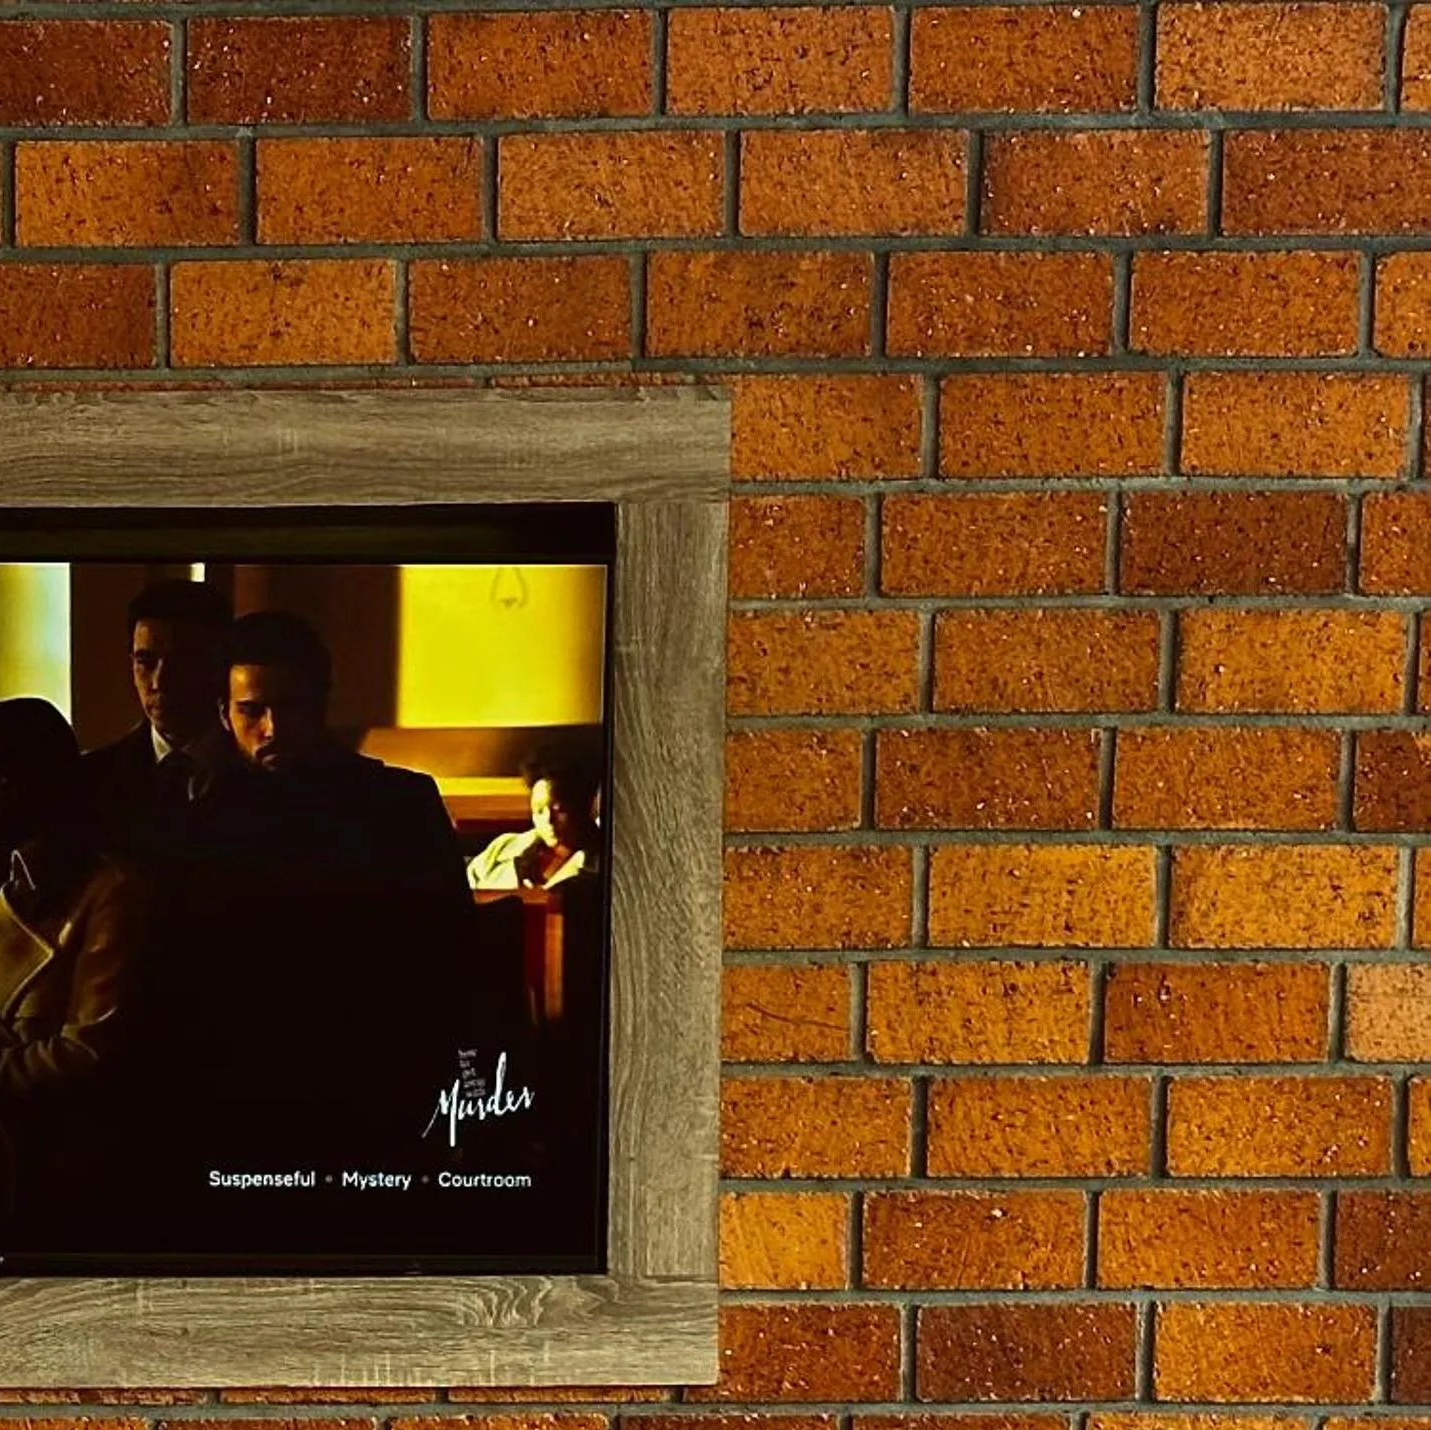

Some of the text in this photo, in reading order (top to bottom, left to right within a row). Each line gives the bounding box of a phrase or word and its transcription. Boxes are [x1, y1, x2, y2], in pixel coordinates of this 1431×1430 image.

[421, 1050, 535, 1148] Murder
[208, 1169, 533, 1190] Suspenseful Mystery Courtroom
